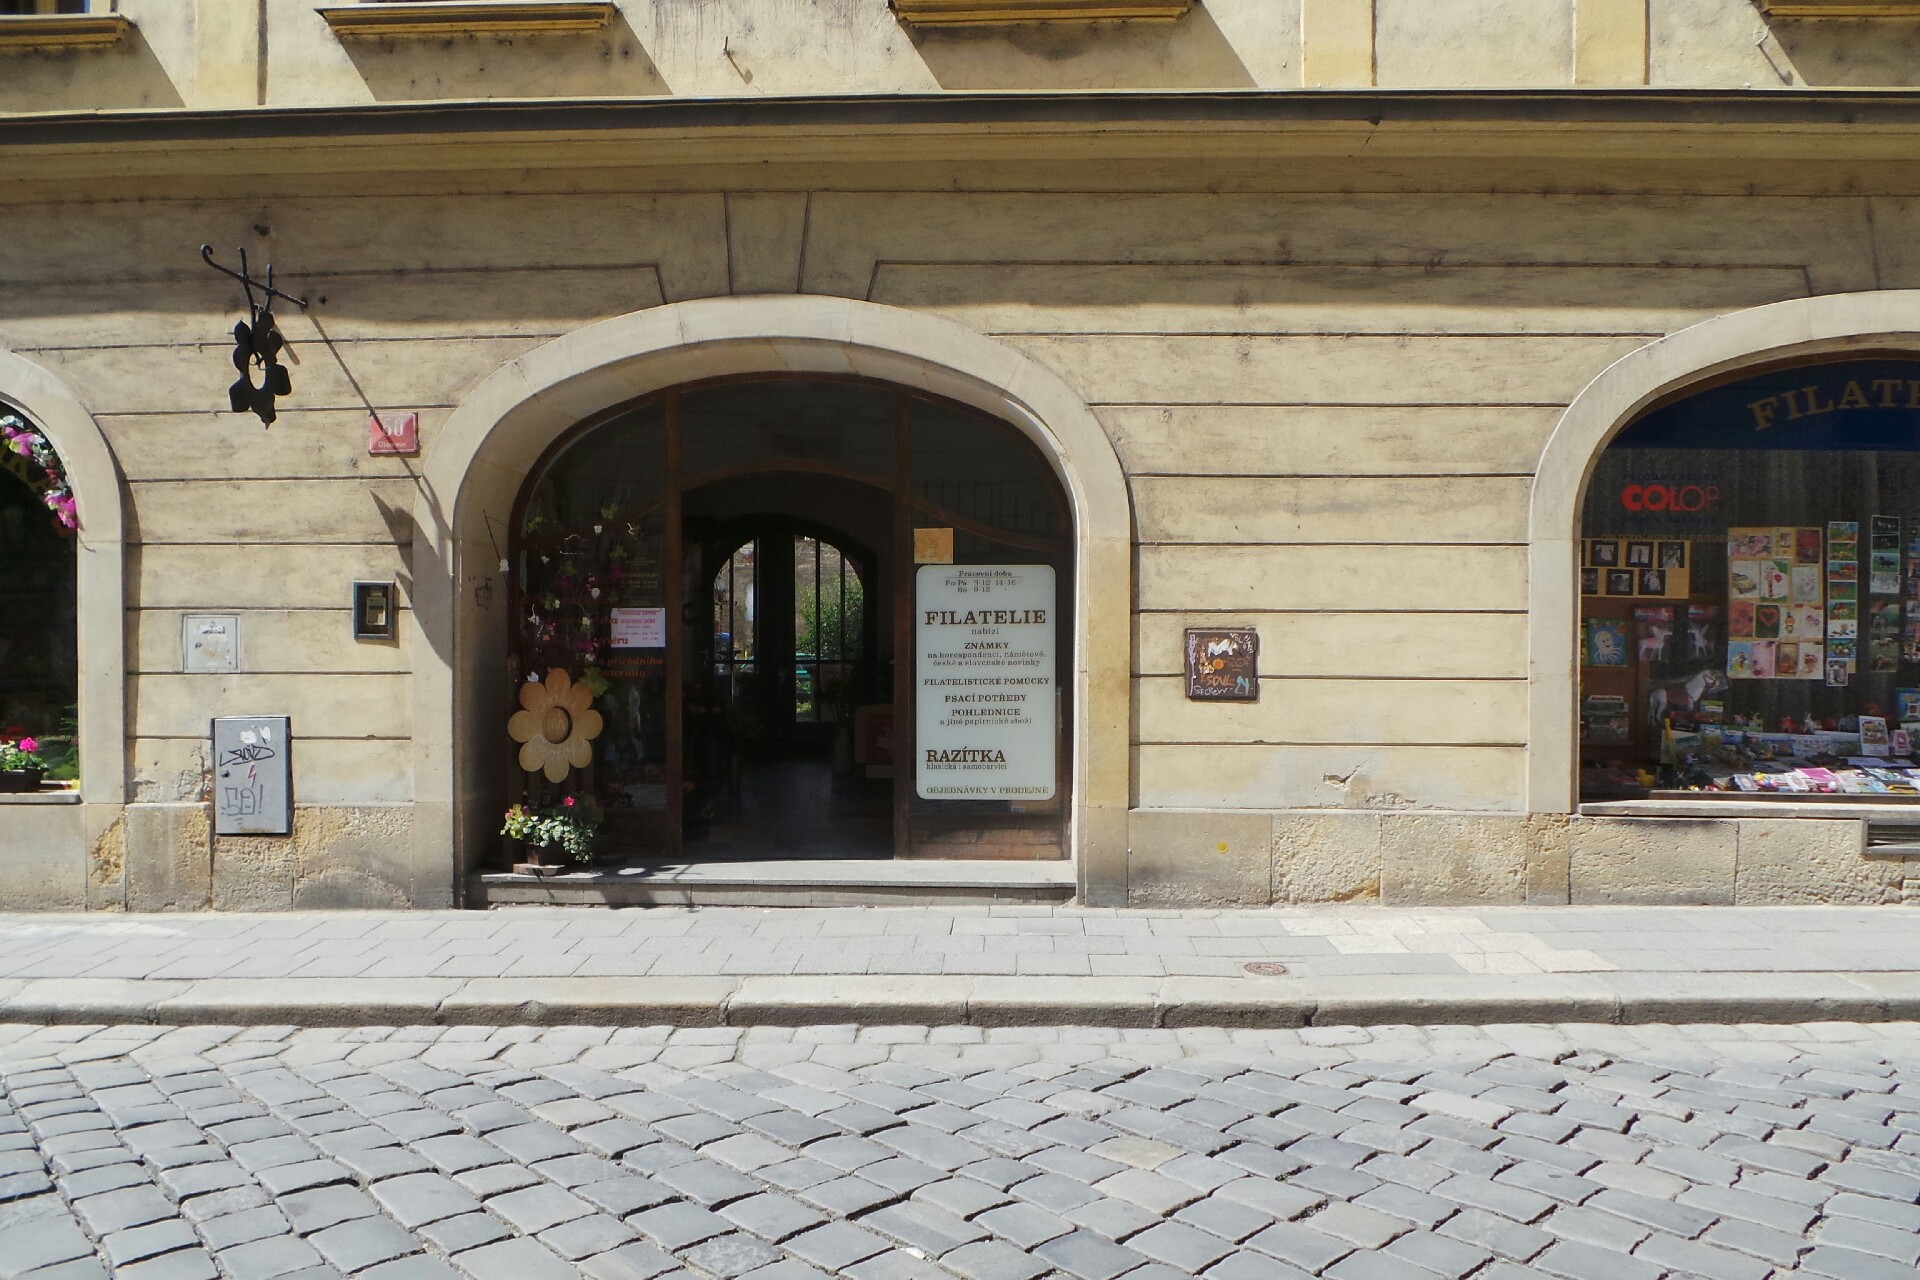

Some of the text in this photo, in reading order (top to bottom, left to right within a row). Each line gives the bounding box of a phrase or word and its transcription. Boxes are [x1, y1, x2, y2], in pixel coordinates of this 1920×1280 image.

[1620, 483, 1721, 512] COLOP
[925, 610, 1046, 625] FILATELIE
[964, 640, 1009, 649] ZNÁMKY
[964, 658, 1005, 666] slovenské
[1007, 658, 1041, 667] novinky
[924, 677, 1002, 686] FILATELISTICKÉ
[944, 693, 1027, 702] PSACÍ POTŘEBY
[951, 708, 1021, 717] POHLEDNICE
[946, 718, 963, 727] jiné
[925, 746, 1006, 763] RAZÍTKA
[926, 785, 988, 794] OBJEDNÁVKY
